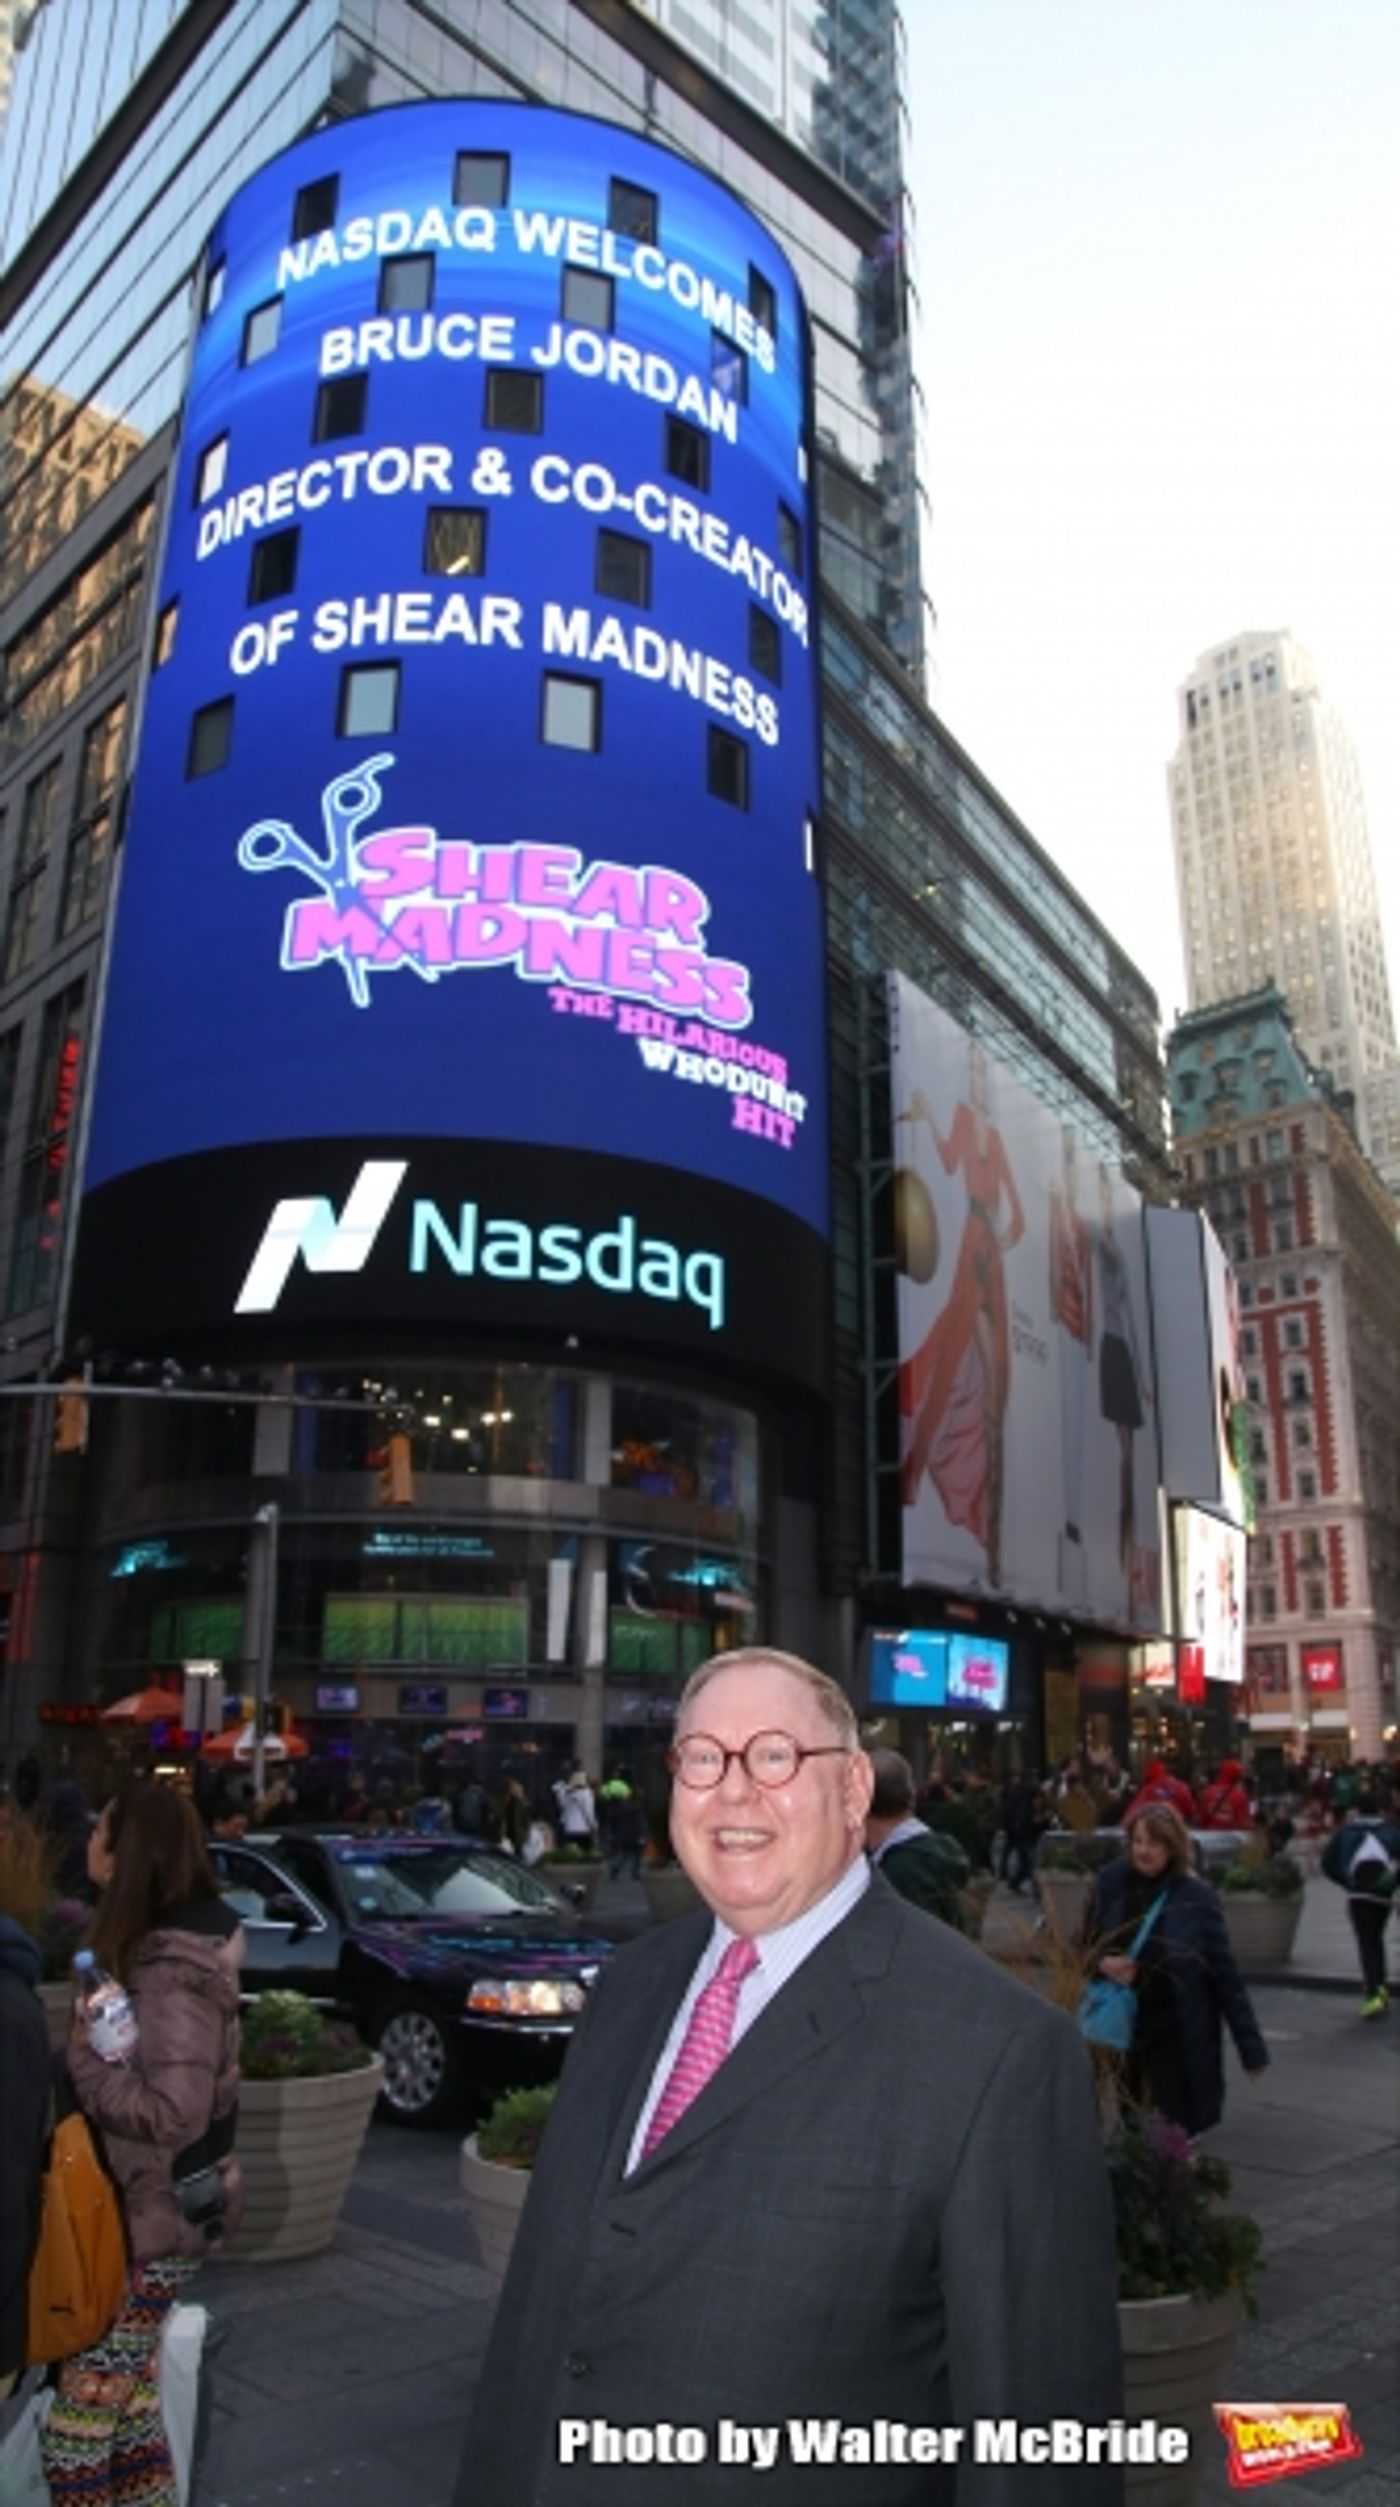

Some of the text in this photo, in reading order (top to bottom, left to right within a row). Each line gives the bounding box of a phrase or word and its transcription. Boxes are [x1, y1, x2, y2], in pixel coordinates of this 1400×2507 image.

[277, 206, 776, 374] NASDAQ WELCOMES
[320, 314, 738, 444] BRUCE JORDAN
[197, 446, 808, 648] DIRECTOR & CO-CREATOR
[230, 594, 779, 746] OF SHEAR MADNESS
[354, 827, 708, 946] SHEAR
[286, 901, 751, 1027] MADNESS
[548, 986, 788, 1083] THE HILARIOUS
[732, 1094, 797, 1149] HIT
[410, 1200, 724, 1330] Nasdaq
